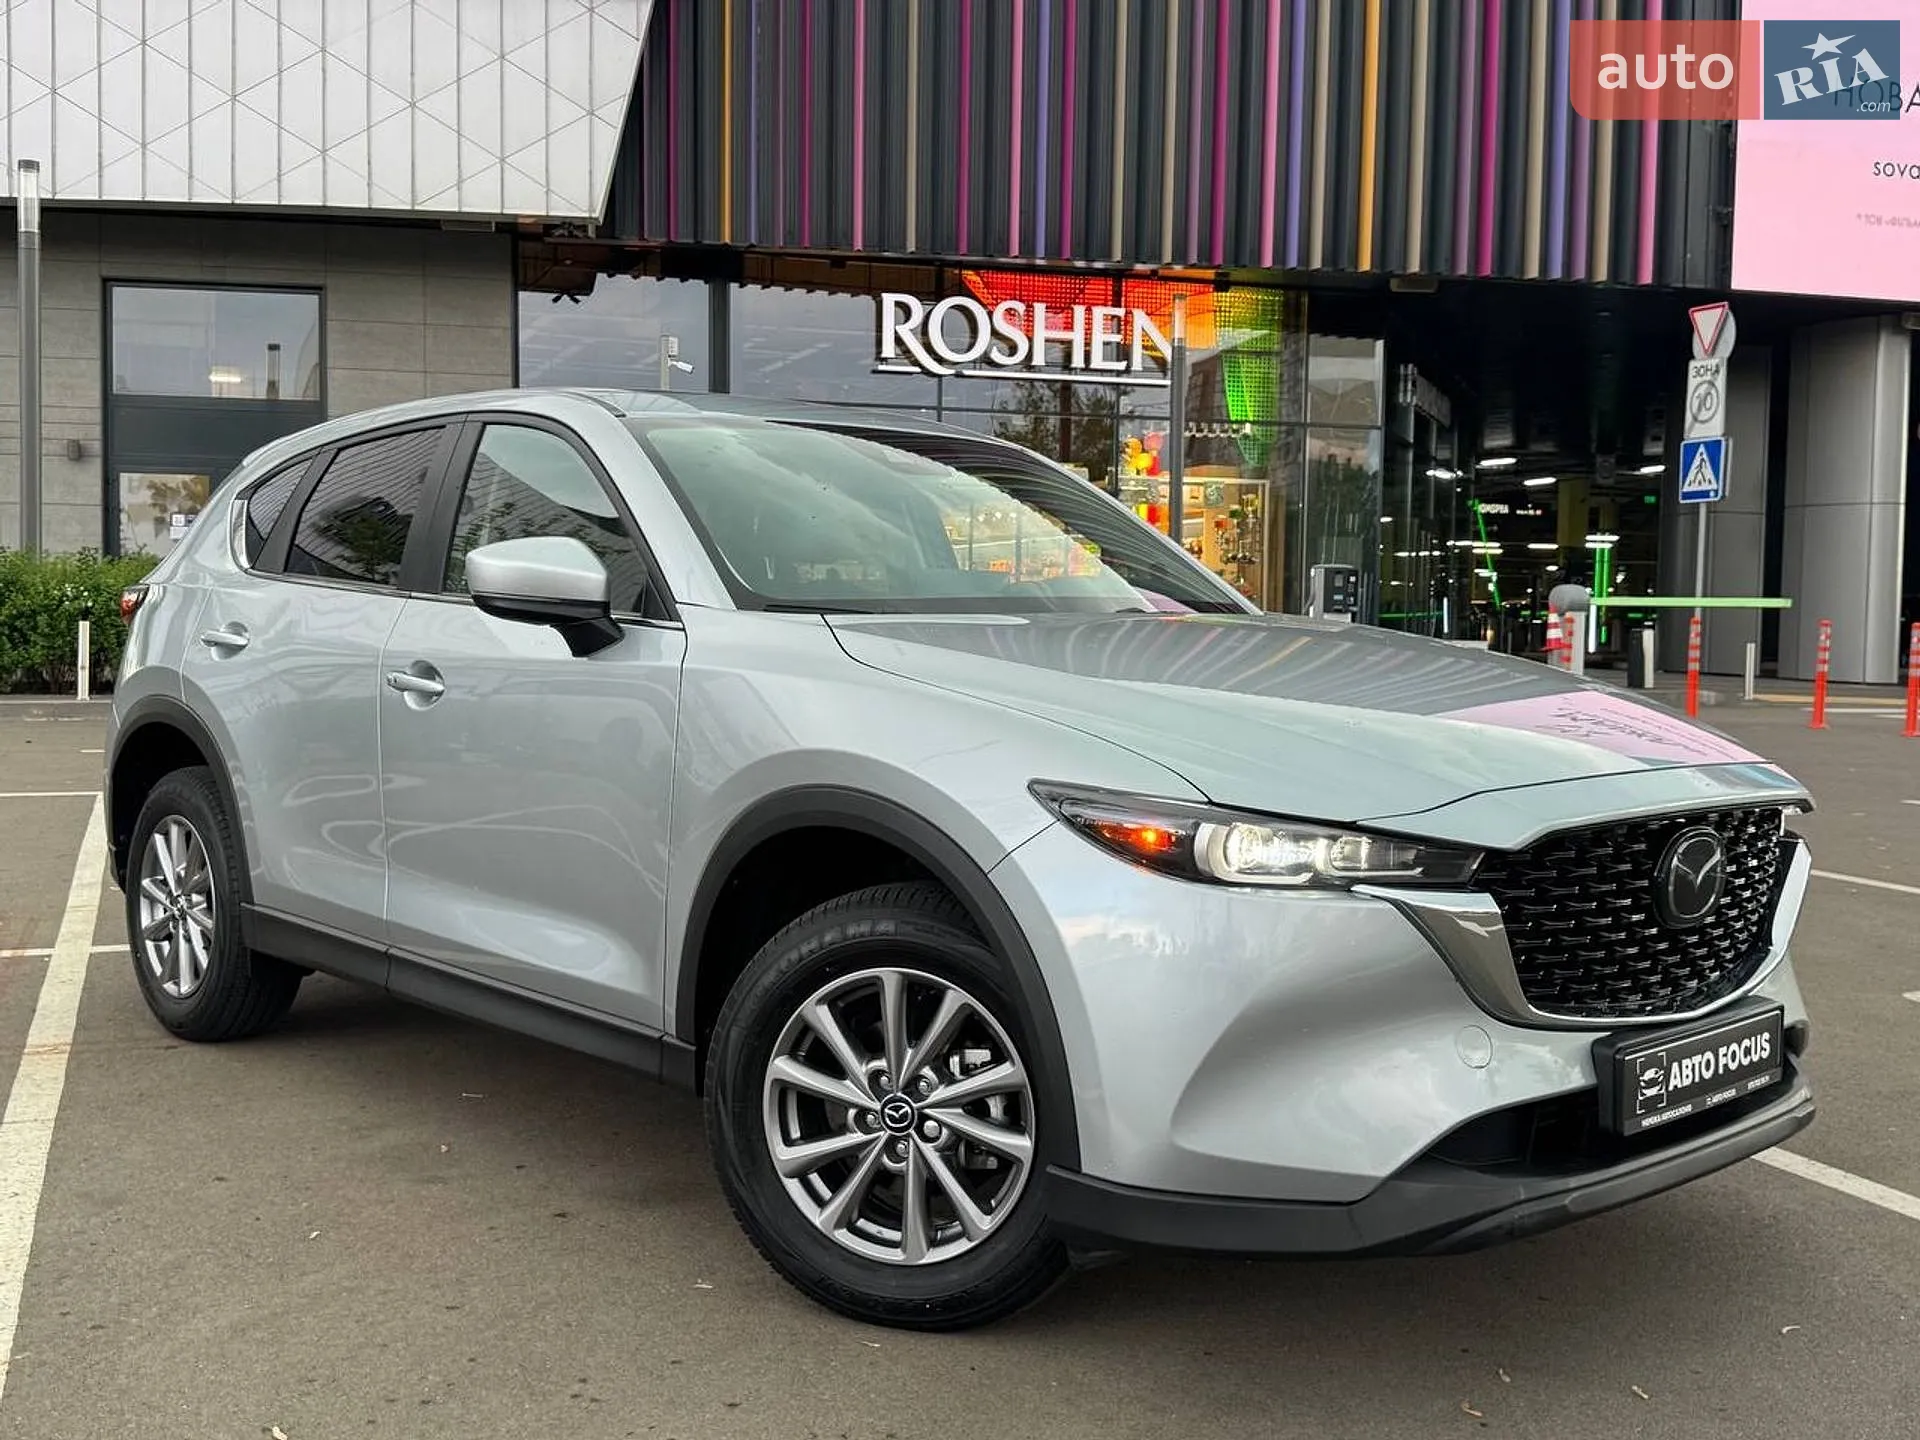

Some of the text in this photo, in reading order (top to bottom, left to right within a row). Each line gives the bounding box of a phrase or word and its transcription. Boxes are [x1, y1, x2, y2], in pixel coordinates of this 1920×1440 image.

[880, 292, 1173, 375] ROSHEN
[1692, 363, 1721, 381] ЗОНА
[1696, 391, 1713, 414] 10
[1669, 1031, 1771, 1091] АВТО FOCUS
